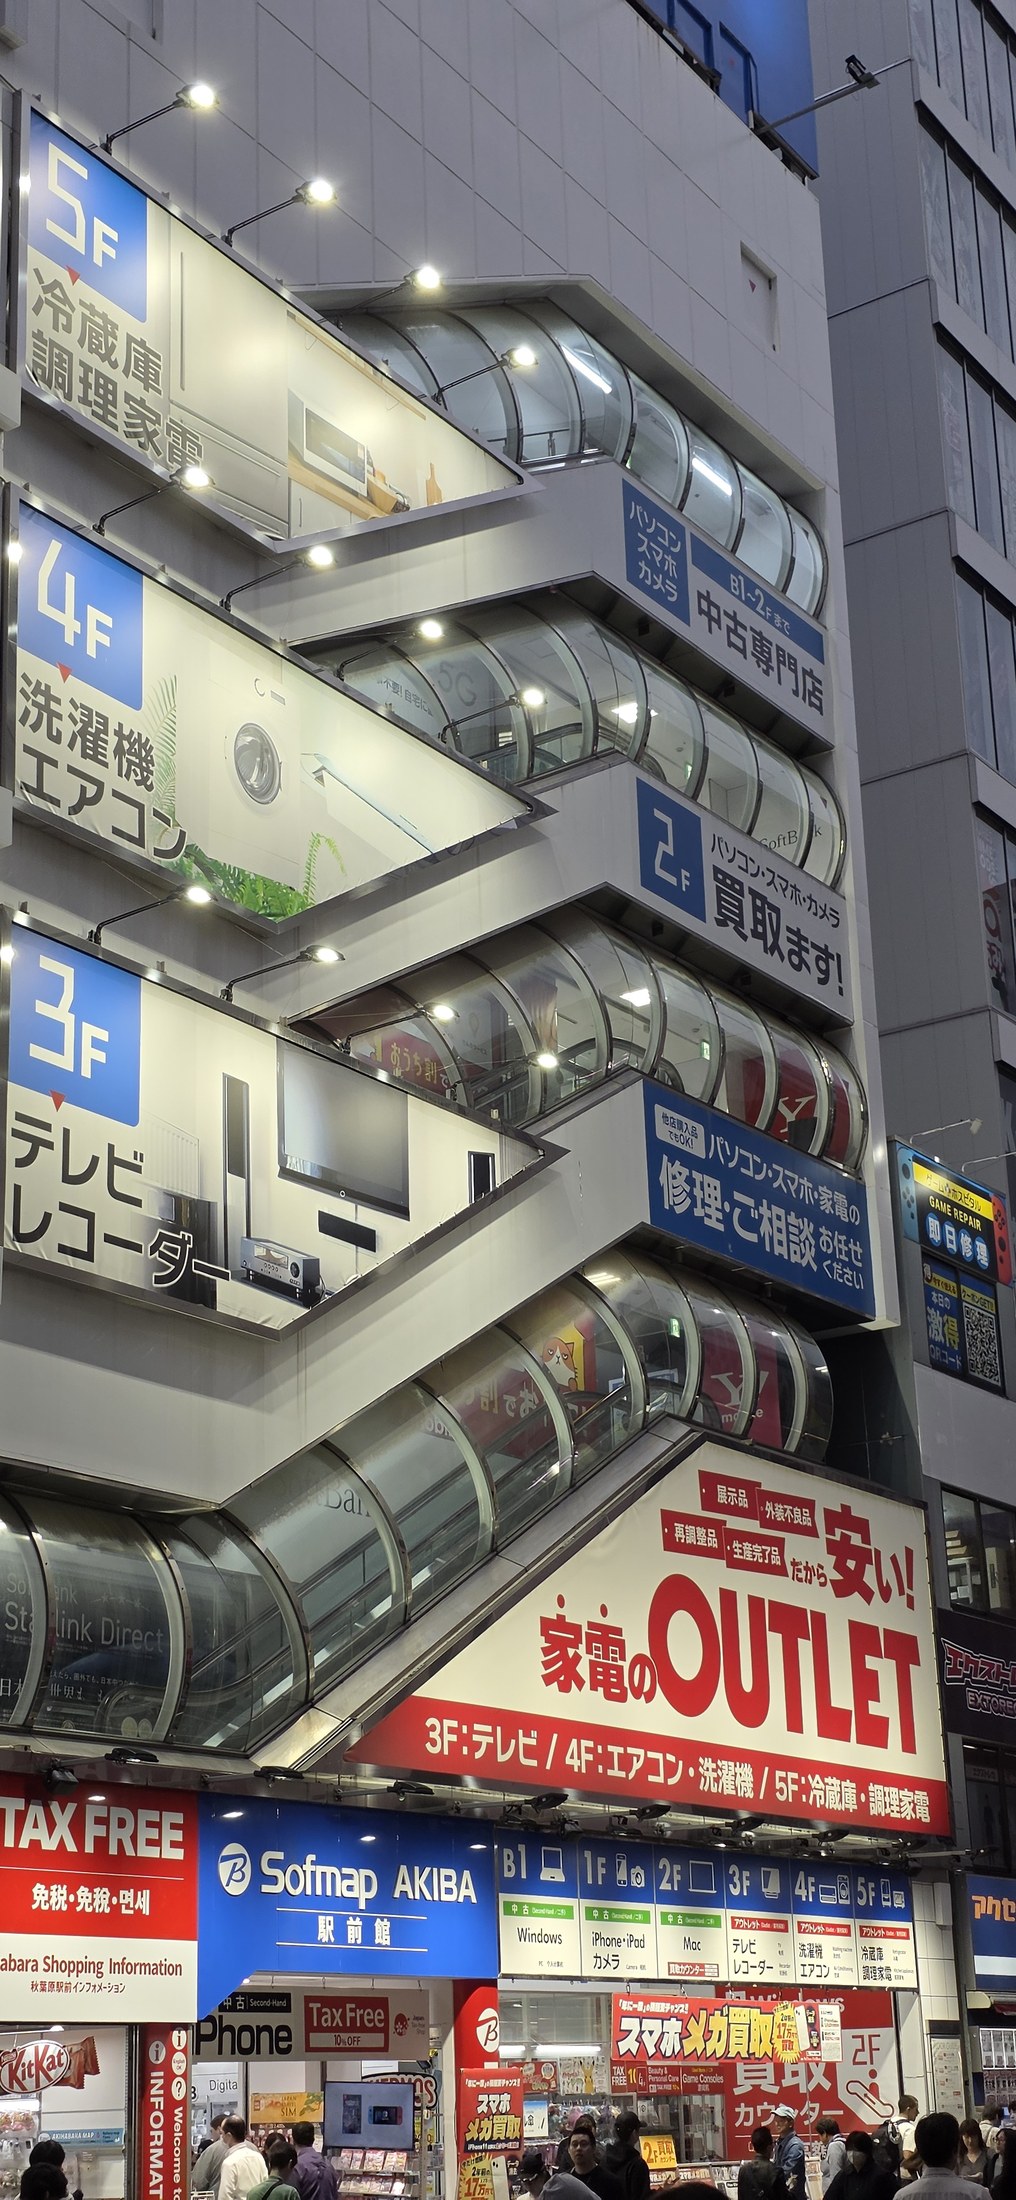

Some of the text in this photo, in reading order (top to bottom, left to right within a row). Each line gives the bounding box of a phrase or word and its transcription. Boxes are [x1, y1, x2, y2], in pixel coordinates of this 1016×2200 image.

[46, 142, 118, 267] 5F
[32, 266, 163, 397] 冷蔵庫
[32, 330, 203, 469] 調理家電
[629, 501, 681, 552] パソコン
[637, 532, 678, 579] スマホ
[639, 560, 678, 602] カメラ
[37, 539, 113, 659] 4F
[697, 589, 824, 716] 中古専門店
[438, 660, 477, 707] 5G
[18, 672, 155, 793] 洗濯機
[21, 743, 187, 860] エアコン
[653, 807, 690, 892] 2F
[760, 822, 822, 850] SoftBk
[711, 832, 840, 929] パソコン・スマホ・カメラ
[712, 864, 844, 997] 買取ます!
[29, 954, 109, 1079] 3F
[661, 1112, 699, 1139] 他店購入品
[668, 1129, 694, 1150] でもOK!
[10, 1111, 144, 1208] テレビ
[708, 1133, 861, 1226] パソコン・スマホ・家電の
[659, 1154, 818, 1273] 修理・ご相談
[929, 1195, 982, 1231] GAME REPAIR
[13, 1183, 231, 1287] レコーダー
[819, 1225, 863, 1268] お任せ
[928, 1216, 989, 1267] 即日修理
[822, 1259, 864, 1291] ください
[931, 1291, 951, 1310] 本日の
[927, 1305, 960, 1350] 激得
[930, 1344, 962, 1370] QRコード
[716, 1484, 749, 1508] 展示品
[764, 1501, 812, 1527] 外装不良品
[674, 1522, 718, 1548] 再調整品
[732, 1540, 781, 1566] 生産完了品
[790, 1503, 915, 1611] だから 安い!
[101, 1616, 164, 1653] Direct
[540, 1572, 921, 1756] 家電の OUTLET
[0, 1796, 185, 1860] TAX FREE
[503, 1844, 527, 1879] B1
[584, 1850, 606, 1885] 1F
[658, 1857, 681, 1891] 2F
[260, 1851, 478, 1910] Sofmap AKIBA
[728, 1864, 750, 1896] 3F
[795, 1870, 815, 1902] 4F
[857, 1876, 875, 1906] 5F
[317, 1915, 391, 1945] 駅前館
[516, 1927, 563, 1945] Windows
[683, 1936, 701, 1951] Mac
[593, 1953, 620, 1970] カメラ
[732, 1938, 757, 1955] テレビ
[798, 1942, 823, 1960] 洗濯機
[861, 1945, 885, 1961] 冷蔵庫
[42, 1955, 104, 1979] Shopping
[109, 1957, 183, 1976] Information
[669, 1963, 704, 1975] 買取カウンター
[733, 1958, 774, 1975] レコーダー
[800, 1963, 830, 1978] エアコン
[862, 1966, 892, 1981] 調理家電
[30, 1980, 126, 1994] 秋葉原駅前インフォメーション
[250, 1996, 287, 2008] Second-Hand
[309, 2002, 385, 2028] Tax Free
[852, 2034, 881, 2066] 2F
[8, 2045, 65, 2092] KitKat
[612, 2066, 625, 2075] TAX
[612, 2076, 627, 2086] FREE
[648, 2067, 663, 2076] Beauty
[682, 2073, 724, 2084] Game Consoles
[280, 2107, 297, 2117] SIM
[477, 2093, 511, 2115] スマホ
[735, 2100, 844, 2128] カウター
[82, 2131, 95, 2139] MAP
[465, 2115, 521, 2141] メガ買取
[173, 2106, 184, 2184] Welcome
[642, 2141, 658, 2164] 2F
